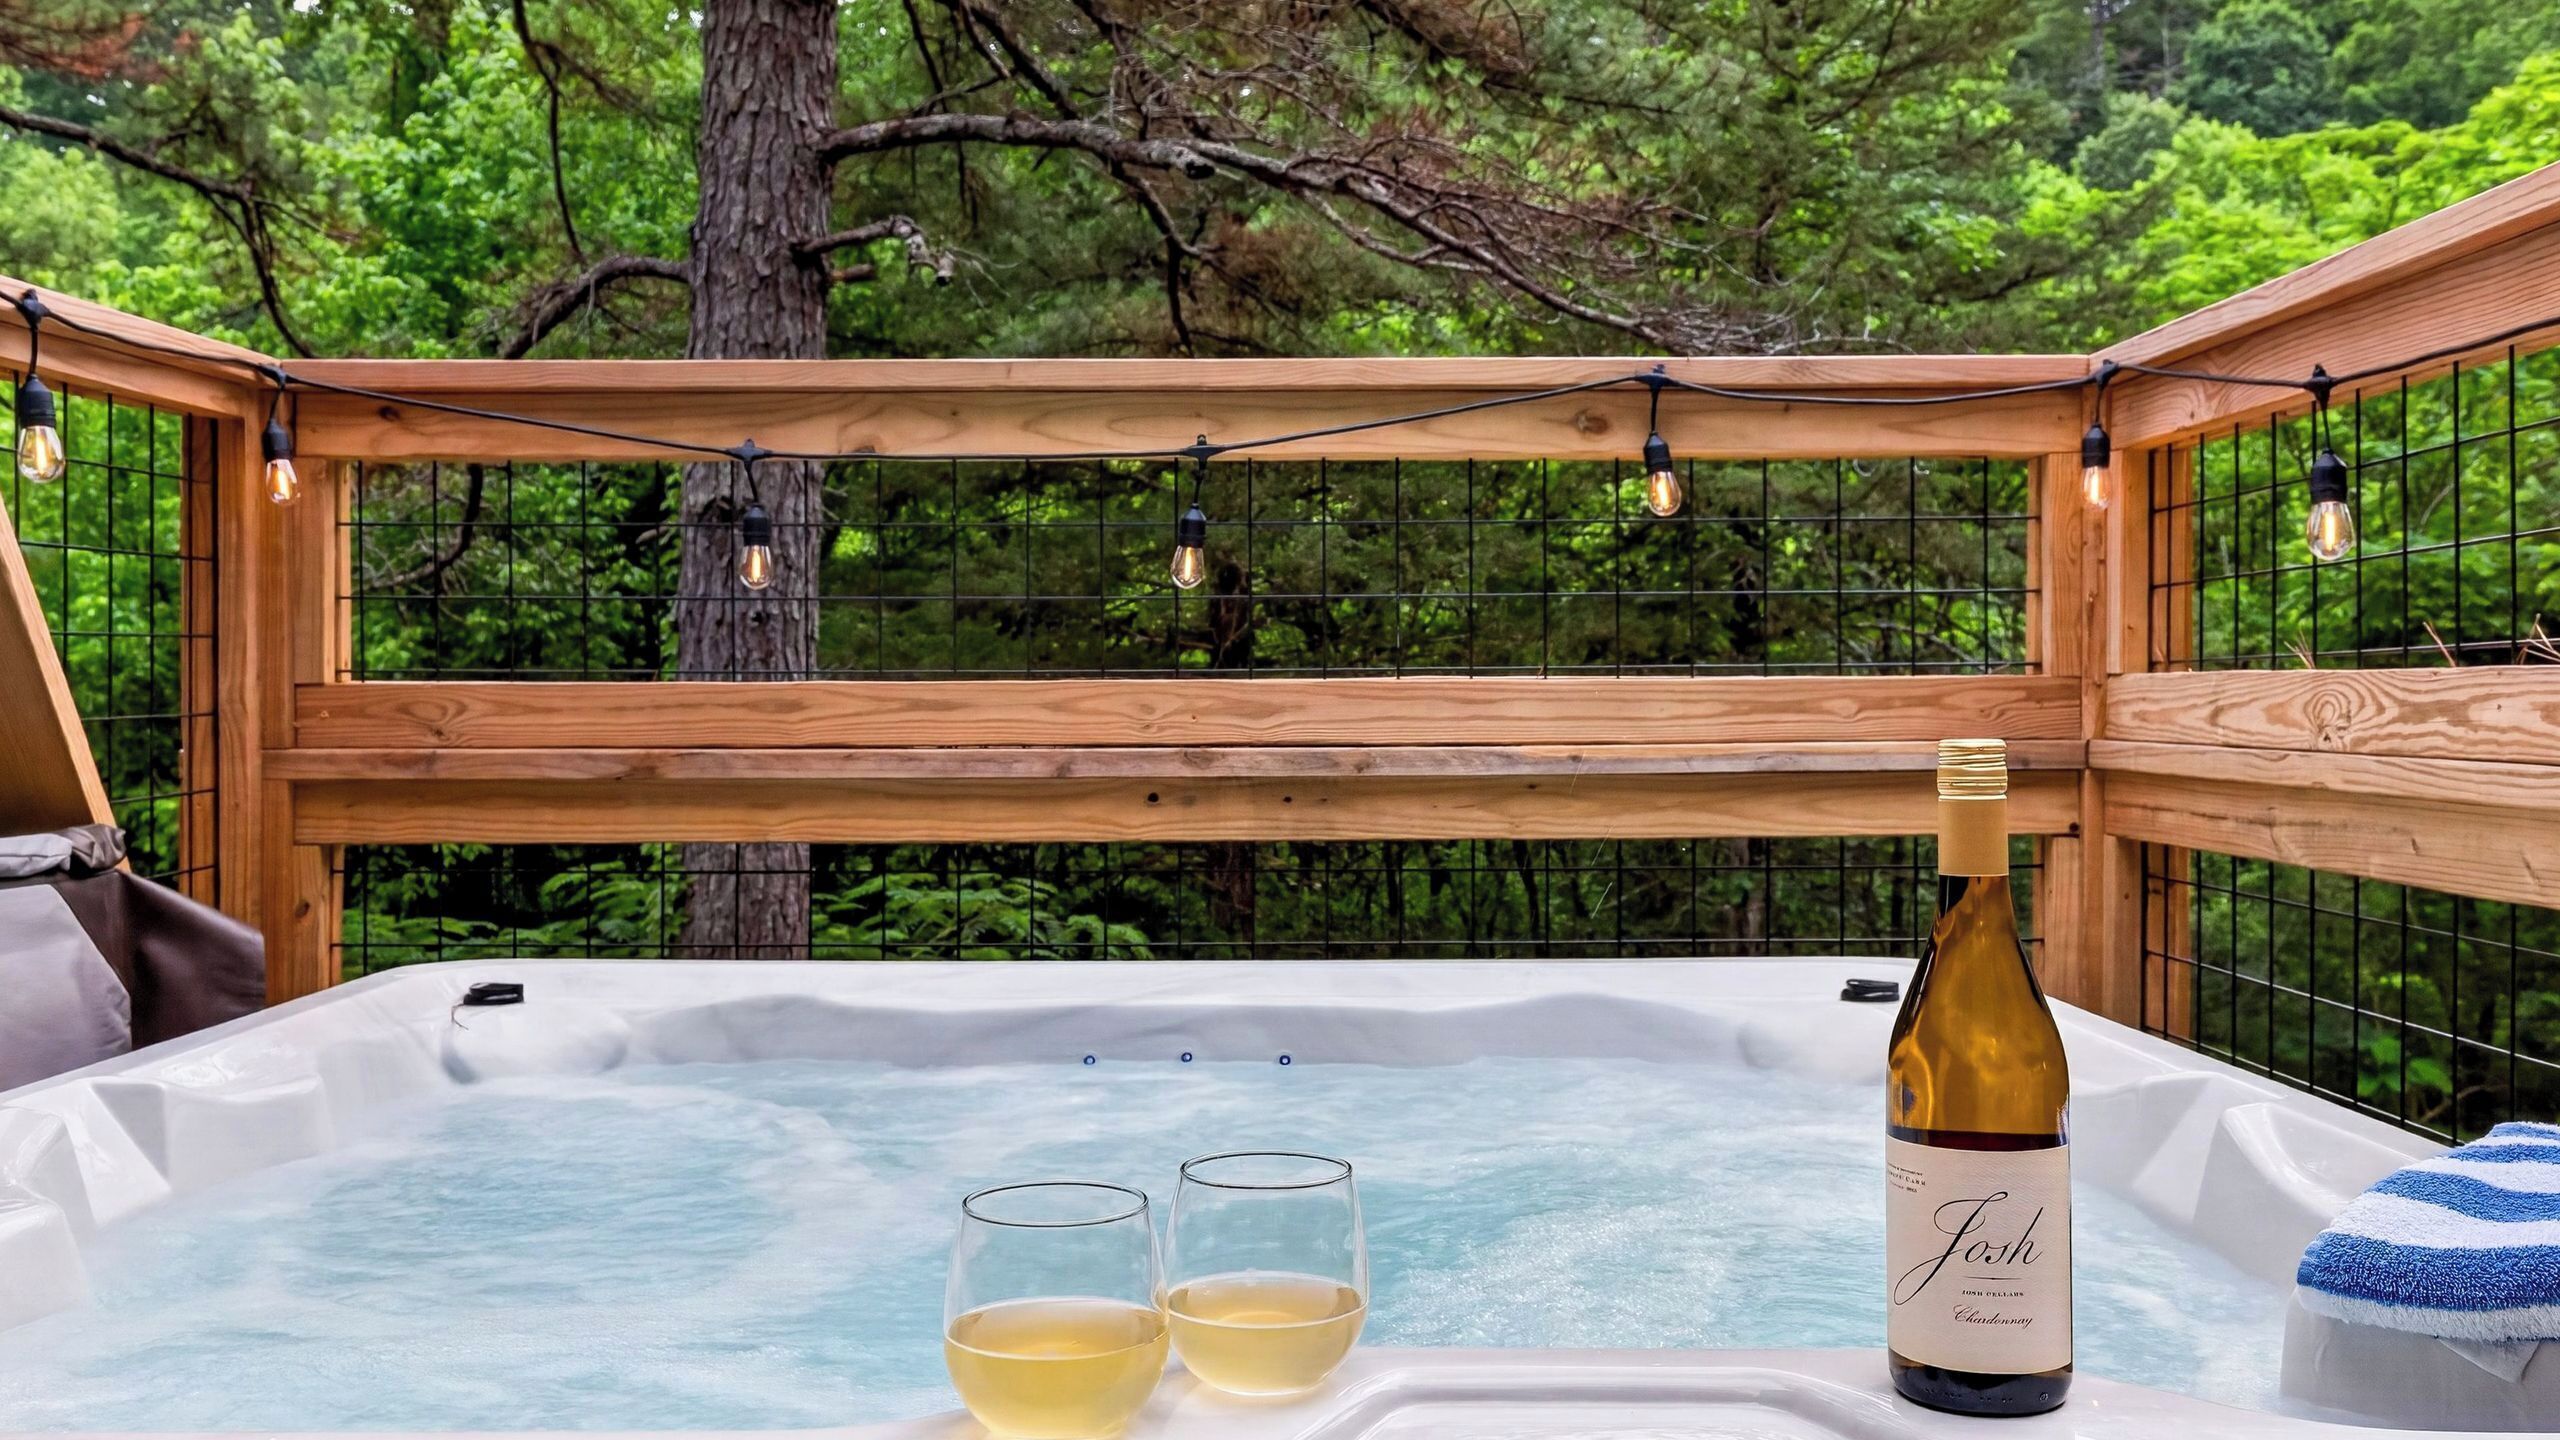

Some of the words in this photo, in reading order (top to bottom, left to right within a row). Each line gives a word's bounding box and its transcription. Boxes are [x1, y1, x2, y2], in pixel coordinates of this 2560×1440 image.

[1893, 1191, 2044, 1306] Josh
[1962, 1289, 1983, 1297] JOSH
[1953, 1304, 2033, 1330] Chardonnay
